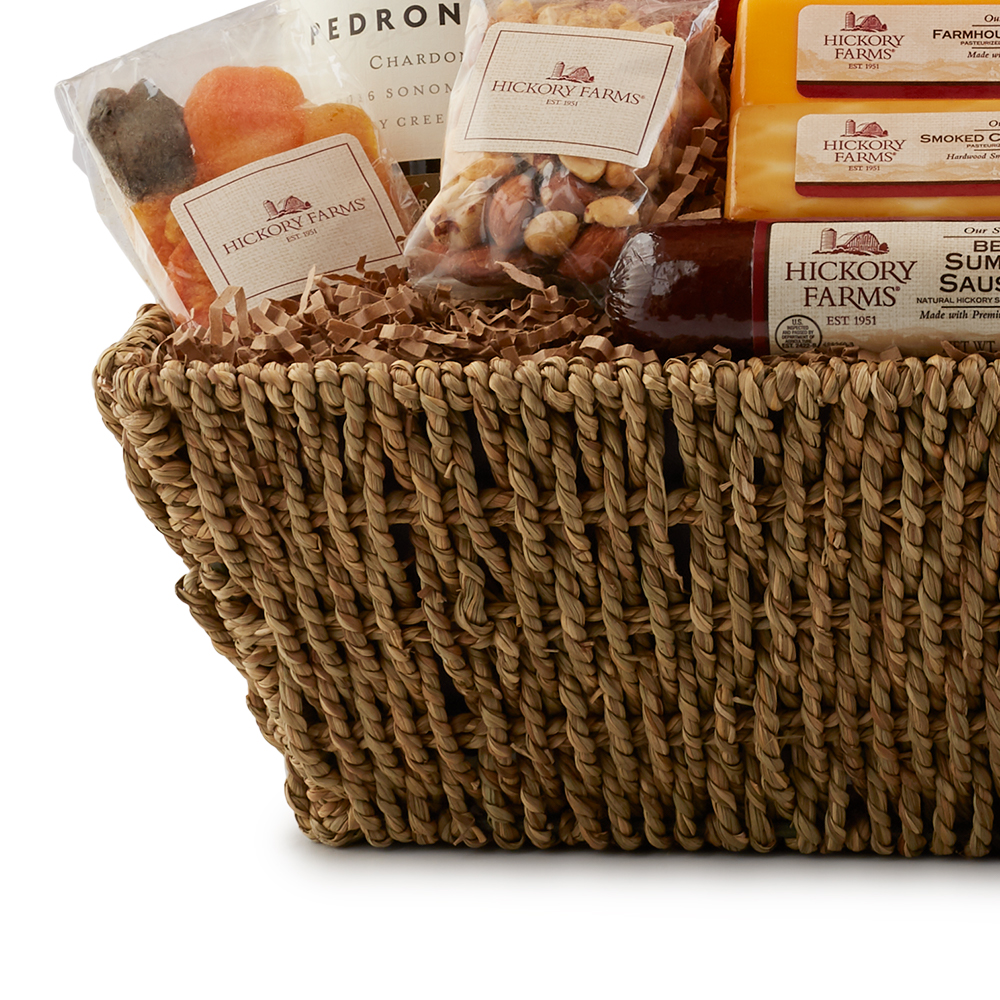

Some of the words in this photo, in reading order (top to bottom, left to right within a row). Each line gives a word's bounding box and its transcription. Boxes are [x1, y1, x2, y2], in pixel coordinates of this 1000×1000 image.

[310, 3, 461, 46] PEDRON
[824, 34, 906, 49] HICKORY
[967, 51, 989, 59] Made
[386, 83, 453, 99] SONOM
[491, 79, 577, 98] HICKORY
[397, 114, 444, 128] CREE
[920, 133, 984, 143] SMOKED
[823, 139, 907, 152] HICKORY
[946, 152, 986, 161] Hardwood
[221, 216, 303, 256] HICKORY
[303, 228, 318, 239] 1951
[785, 260, 918, 285] HICKORY
[854, 315, 877, 326] 1951
[919, 310, 945, 320] Made
[948, 310, 968, 320] with
